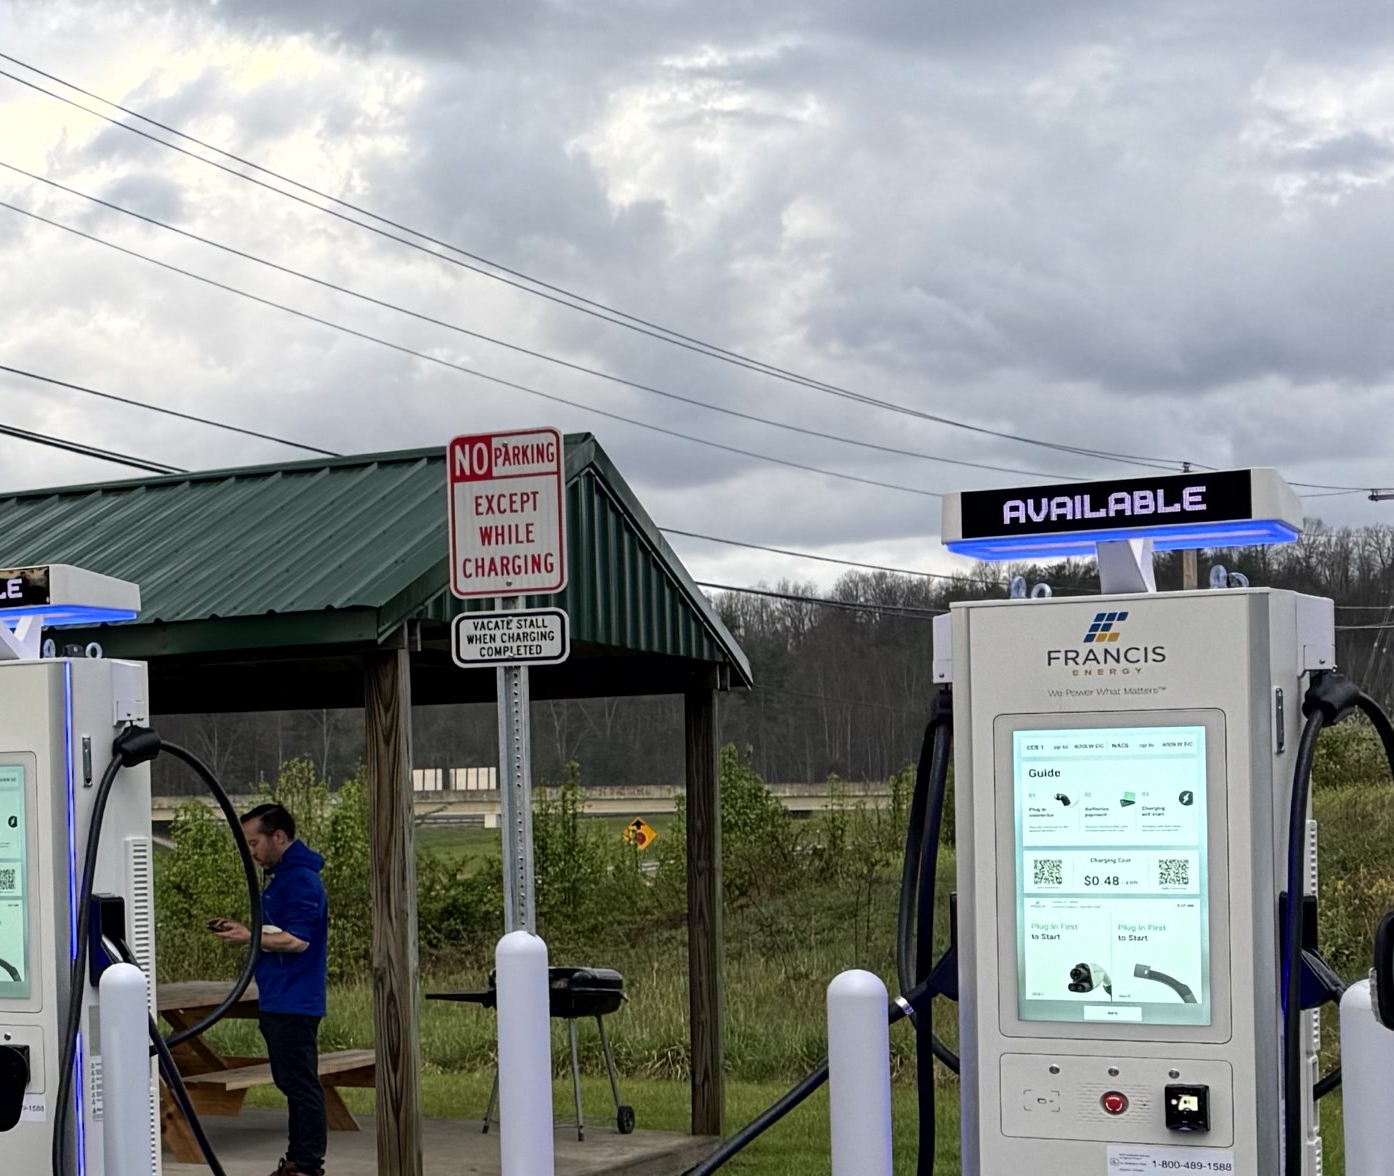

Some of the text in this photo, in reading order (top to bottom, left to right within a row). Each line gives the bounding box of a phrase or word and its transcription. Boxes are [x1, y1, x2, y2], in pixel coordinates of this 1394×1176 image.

[454, 442, 555, 477] NO PARKING
[474, 491, 540, 516] EXCEPT
[1003, 485, 1207, 525] AVAILABLE
[479, 523, 535, 547] WHILE
[463, 552, 555, 579] CHARGING
[472, 618, 548, 631] VACATE STALL
[466, 630, 555, 645] WHEN CHARGING
[479, 644, 543, 658] COMPLETED
[1047, 646, 1166, 666] FRANCIS
[1072, 667, 1142, 676] ENERGY
[1048, 689, 1063, 697] We
[1065, 688, 1094, 696] Power
[1096, 688, 1121, 696] What
[1028, 768, 1061, 778] Guide
[1084, 874, 1120, 886] $0.48
[1031, 923, 1049, 931] Plug
[1118, 924, 1136, 932] Plug
[1128, 934, 1148, 942] Start
[1152, 1160, 1232, 1171] 1-800-489-1588
